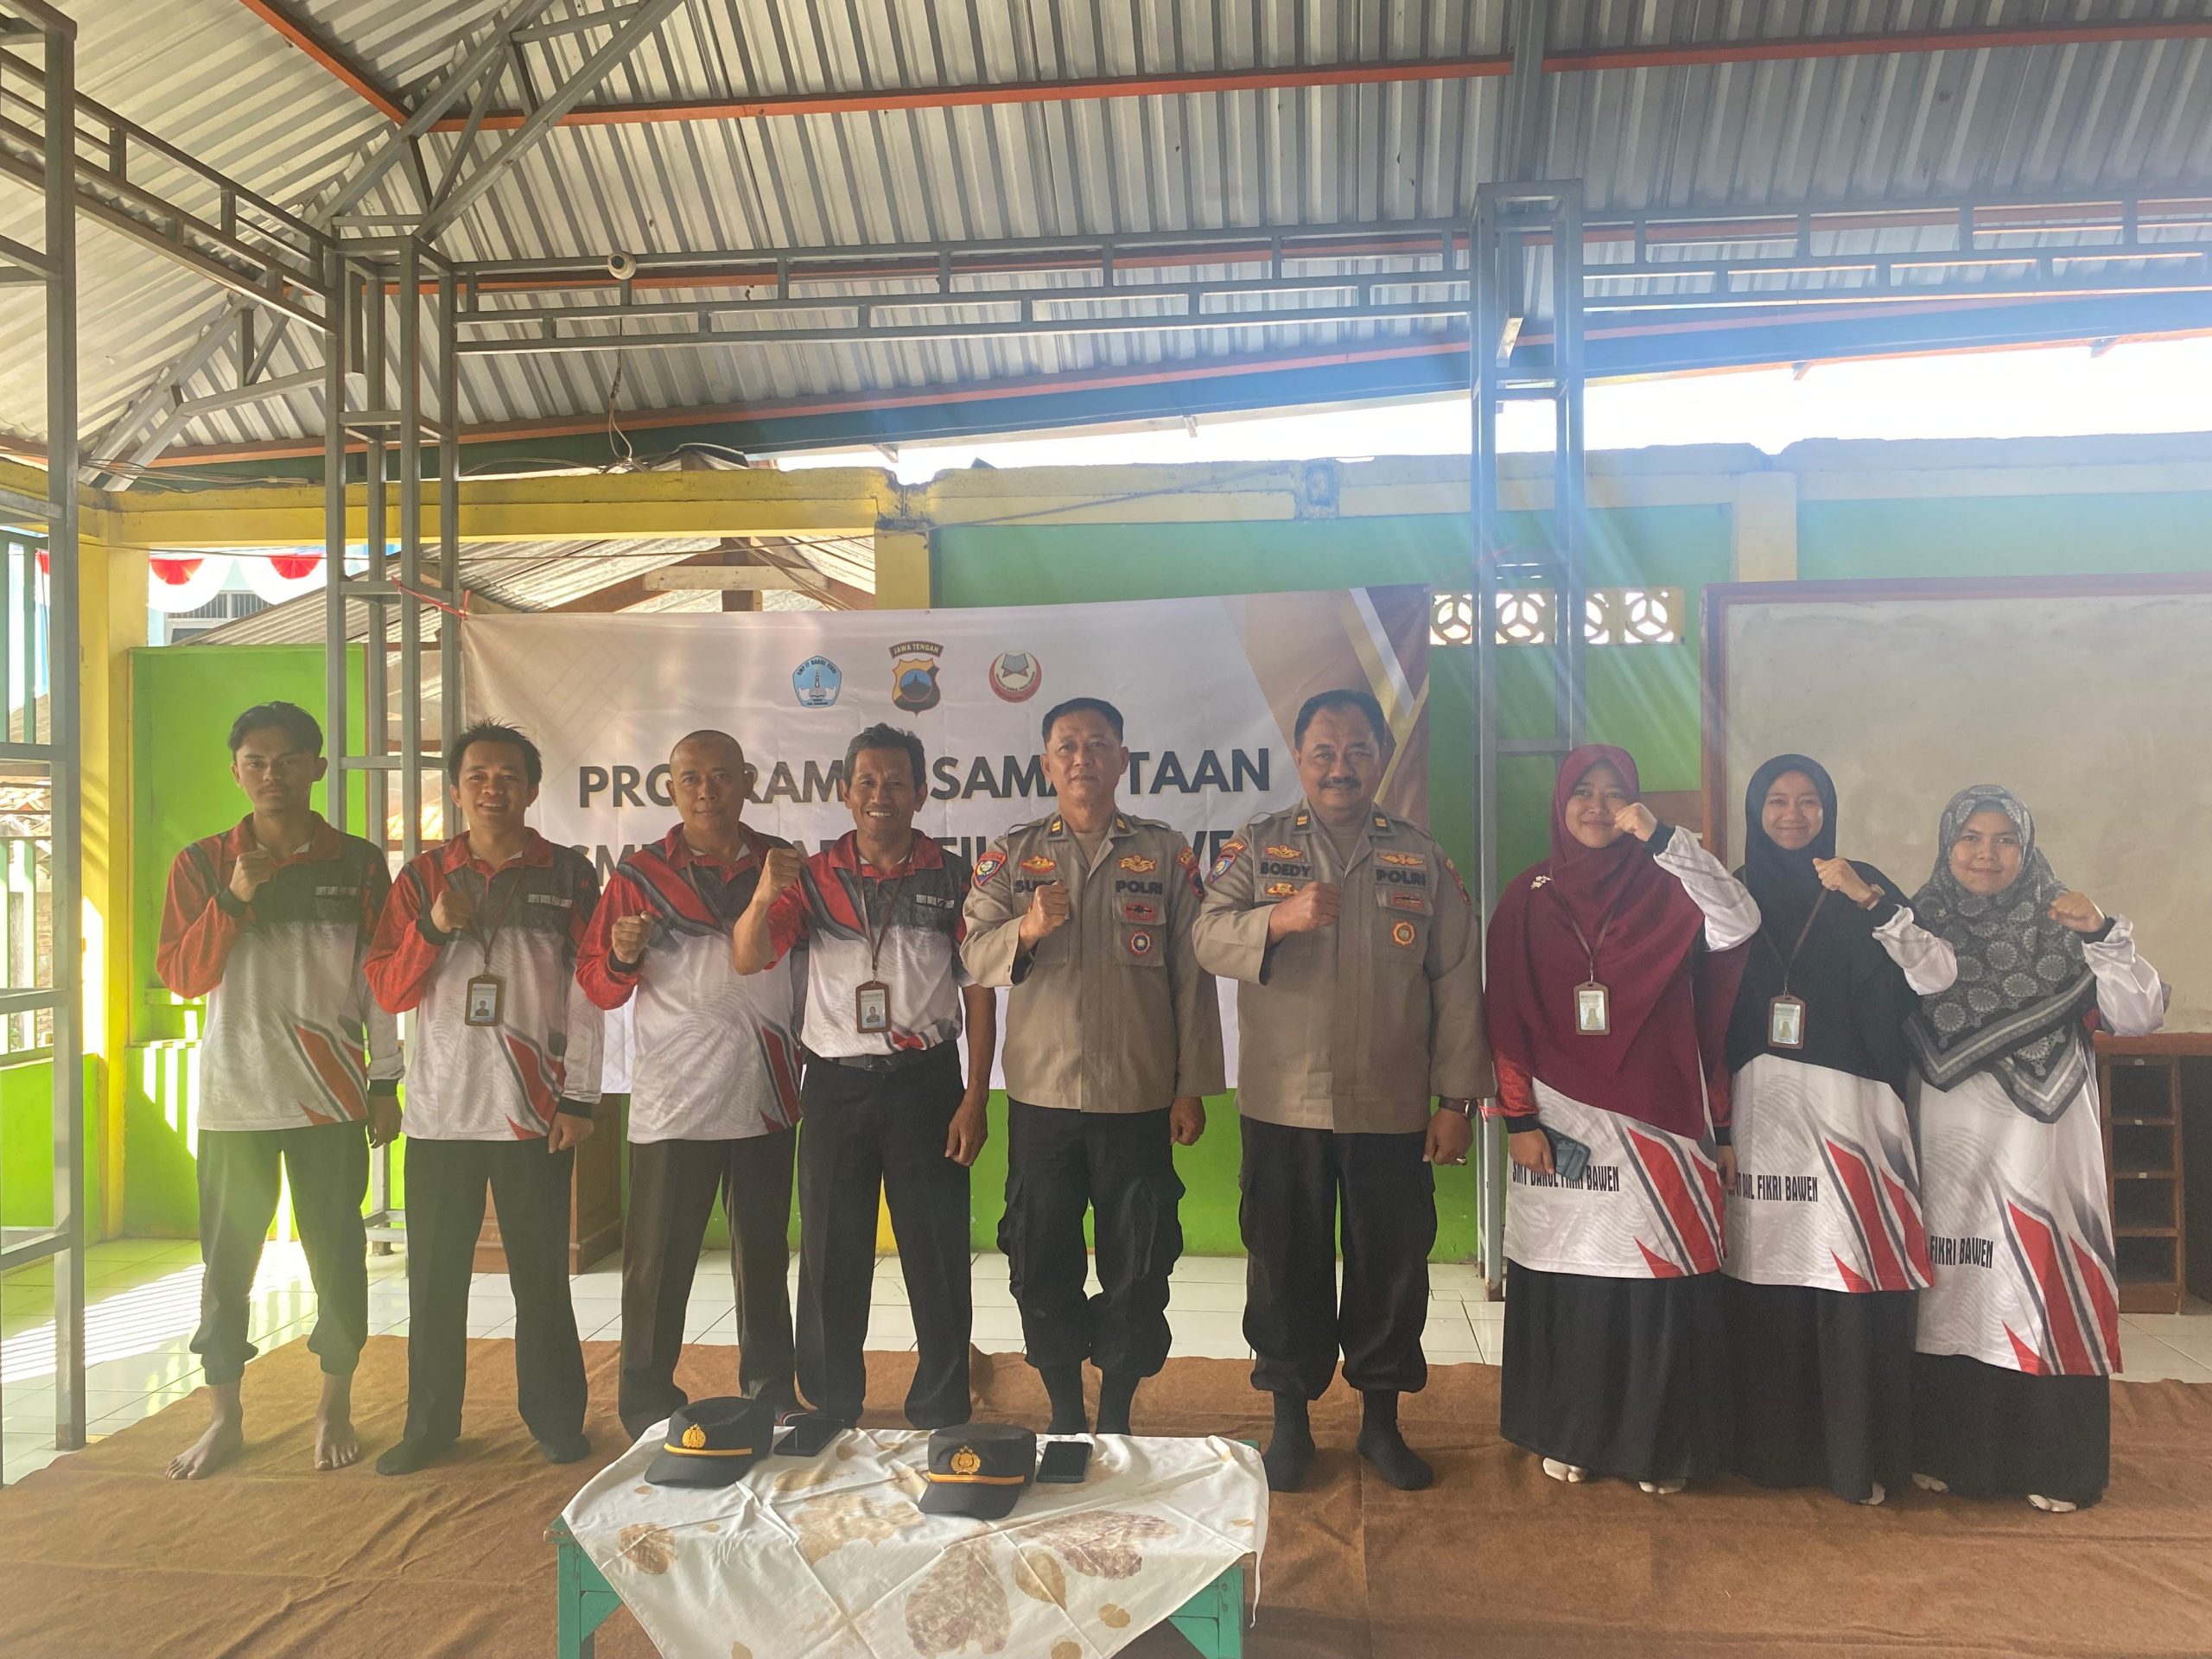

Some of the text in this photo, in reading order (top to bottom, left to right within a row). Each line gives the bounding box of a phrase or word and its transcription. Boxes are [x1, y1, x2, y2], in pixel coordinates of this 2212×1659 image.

[893, 643, 940, 655] JAWA TENGAH
[930, 747, 1270, 800] SAMTAAN
[1260, 862, 1312, 878] BOEDY
[1376, 869, 1427, 887] POLRI
[1116, 880, 1163, 895] POLRI
[1586, 1165, 1620, 1192] BAWEN
[1757, 1174, 1782, 1201] FIKRI
[1785, 1176, 1818, 1202] BAWEN
[1929, 1235, 1994, 1269] FIKRI BAWEN
